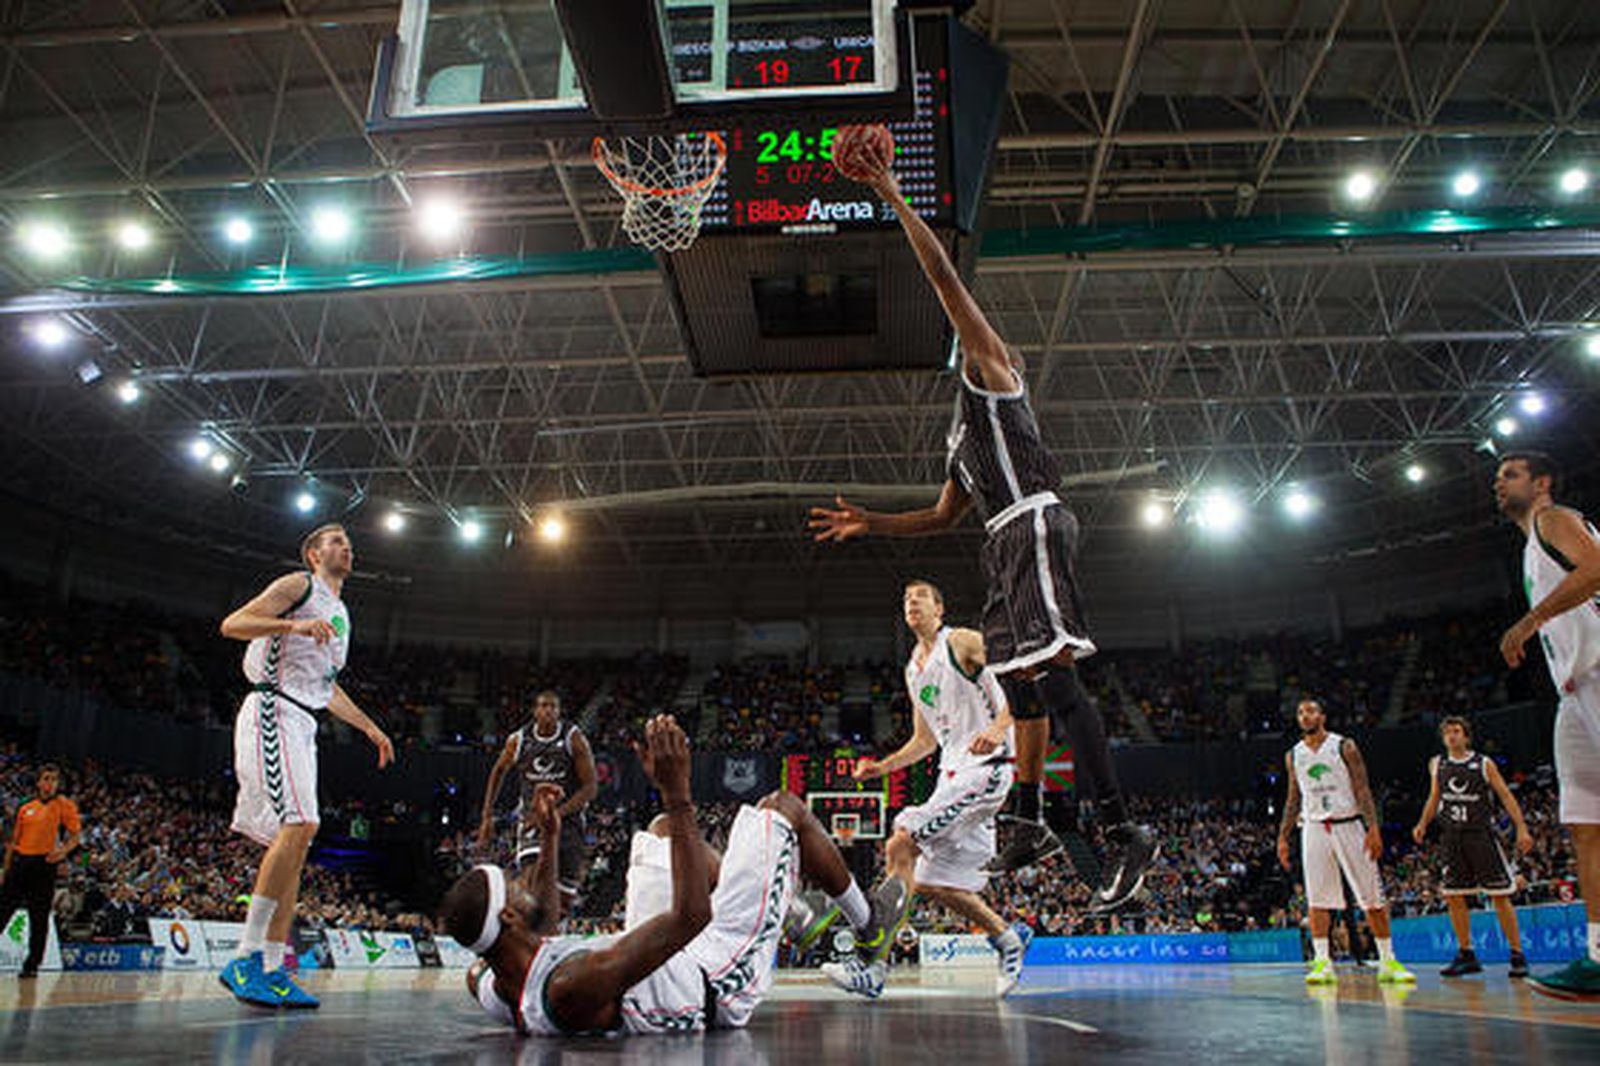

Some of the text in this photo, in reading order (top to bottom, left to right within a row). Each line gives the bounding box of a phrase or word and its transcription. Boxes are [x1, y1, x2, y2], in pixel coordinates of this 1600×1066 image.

[756, 59, 789, 84] 19
[827, 56, 862, 81] 17
[757, 128, 838, 163] 24:5
[1450, 804, 1468, 822] 31
